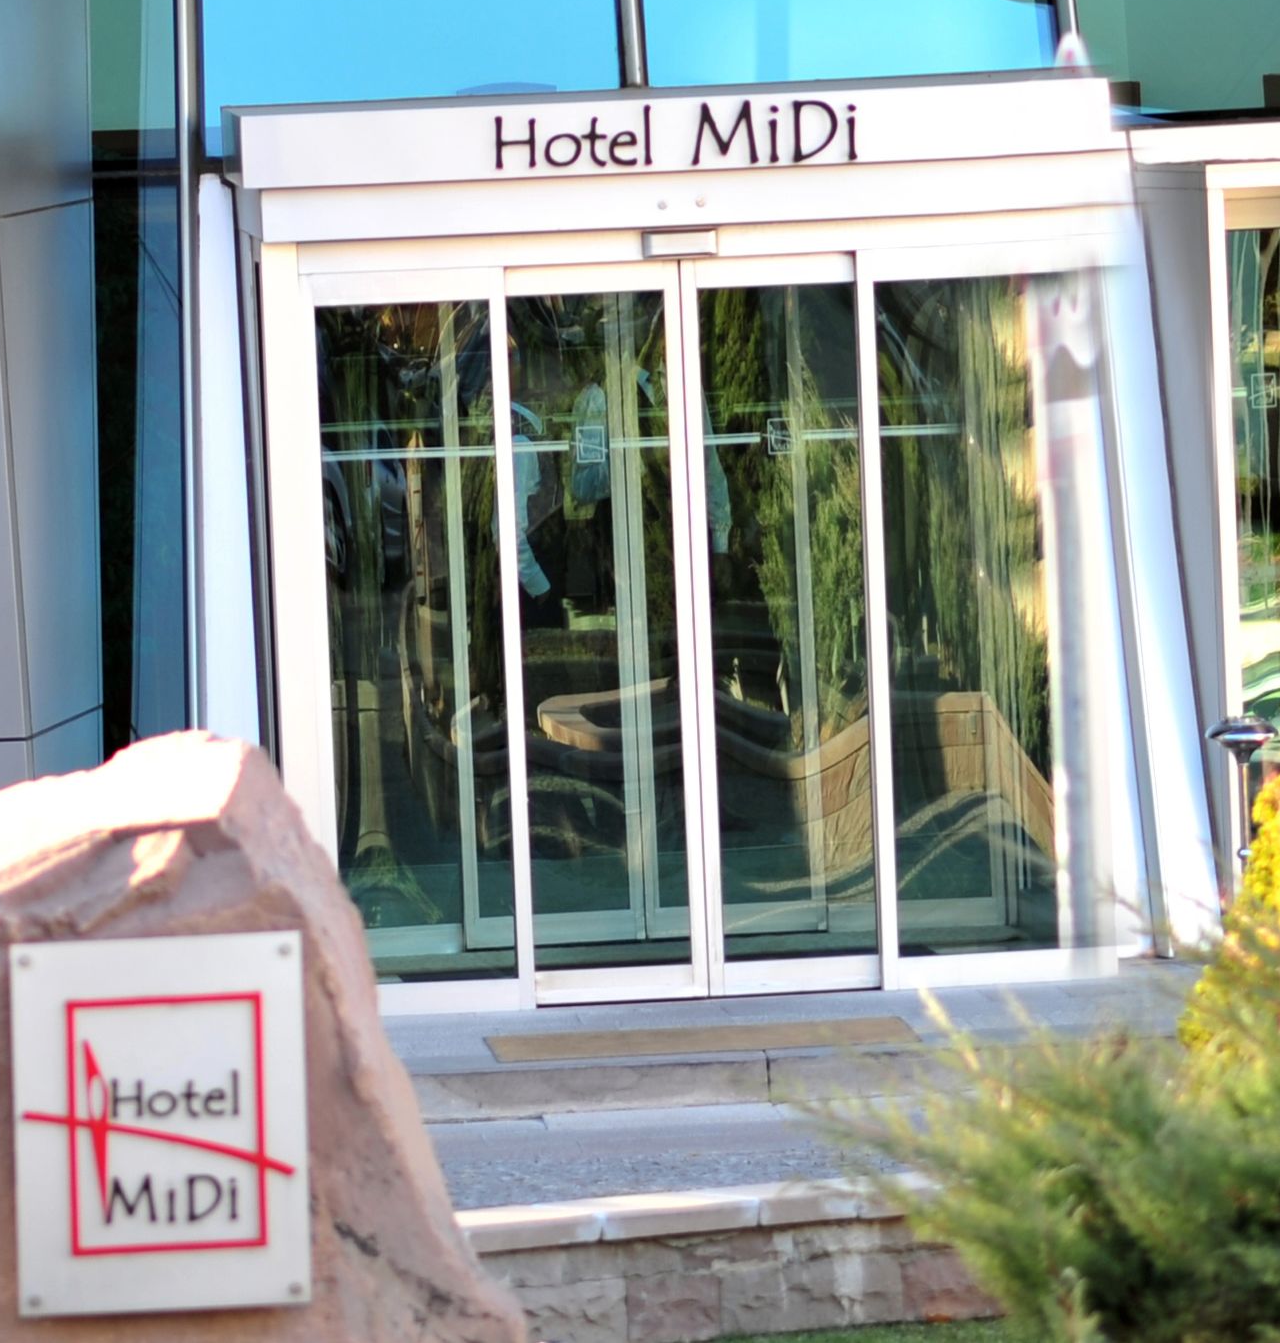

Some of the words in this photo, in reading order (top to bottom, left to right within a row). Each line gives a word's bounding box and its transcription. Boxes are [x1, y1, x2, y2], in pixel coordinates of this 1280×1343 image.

[494, 104, 653, 170] Hotel
[691, 100, 859, 165] MiDi
[111, 1070, 239, 1119] Hotel
